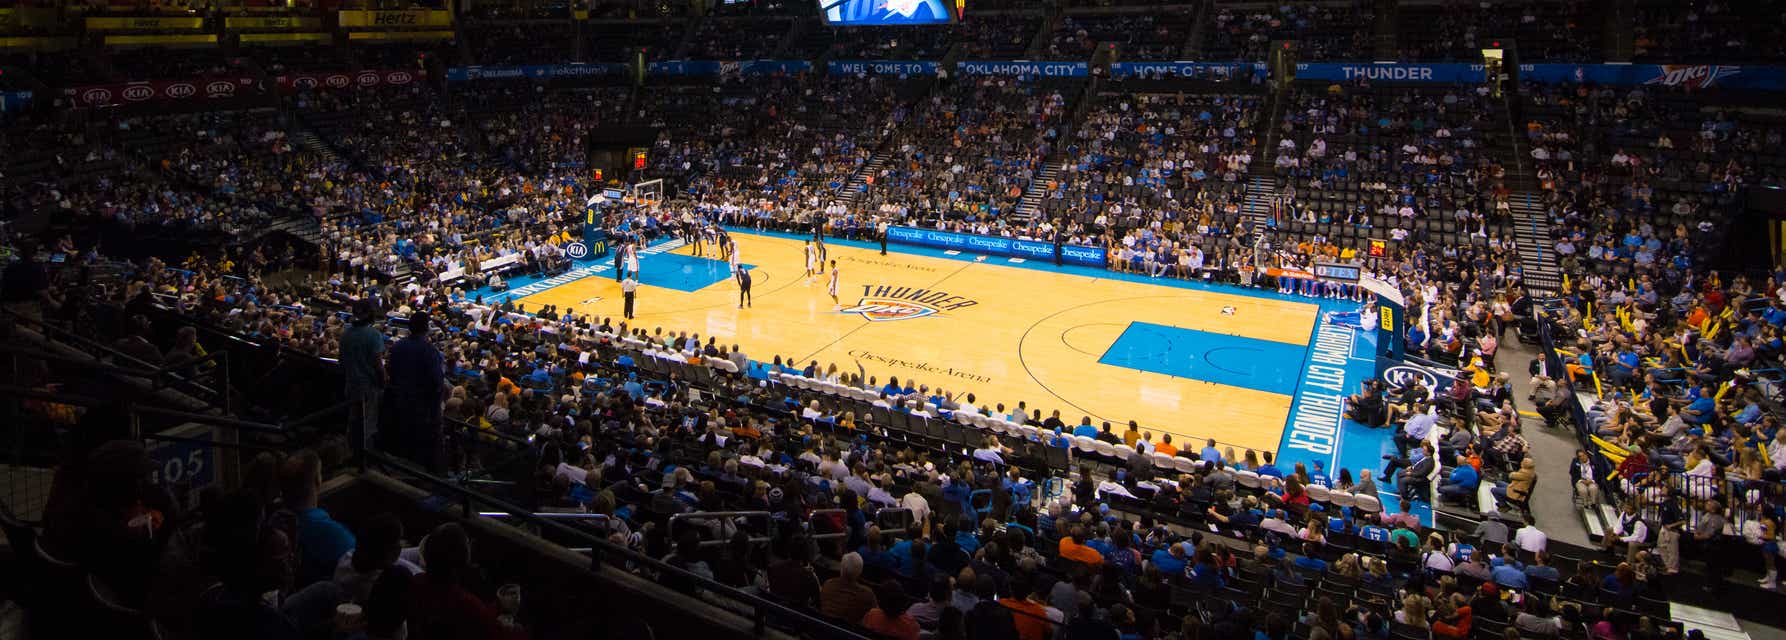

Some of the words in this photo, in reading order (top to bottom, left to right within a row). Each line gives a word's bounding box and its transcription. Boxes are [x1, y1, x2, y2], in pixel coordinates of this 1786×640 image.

[374, 11, 417, 25] Hertz
[841, 63, 901, 74] WELOME
[904, 63, 922, 74] TO
[966, 64, 1041, 76] OKLAHOMA
[1044, 64, 1076, 76] CITY
[1341, 66, 1433, 80] THUNDER
[1663, 66, 1708, 86] OKC
[888, 227, 924, 241] Chesapeake
[927, 232, 965, 245] Chesapeake
[968, 236, 1008, 250] Chesapeake
[1012, 241, 1053, 256] Chesapeake
[862, 284, 979, 311] THUNDER
[1383, 308, 1392, 328] Hertz
[847, 350, 948, 373] Chesapeake
[945, 367, 992, 384] Arena
[1304, 364, 1346, 393] CITY
[1287, 391, 1342, 456] THUNDER
